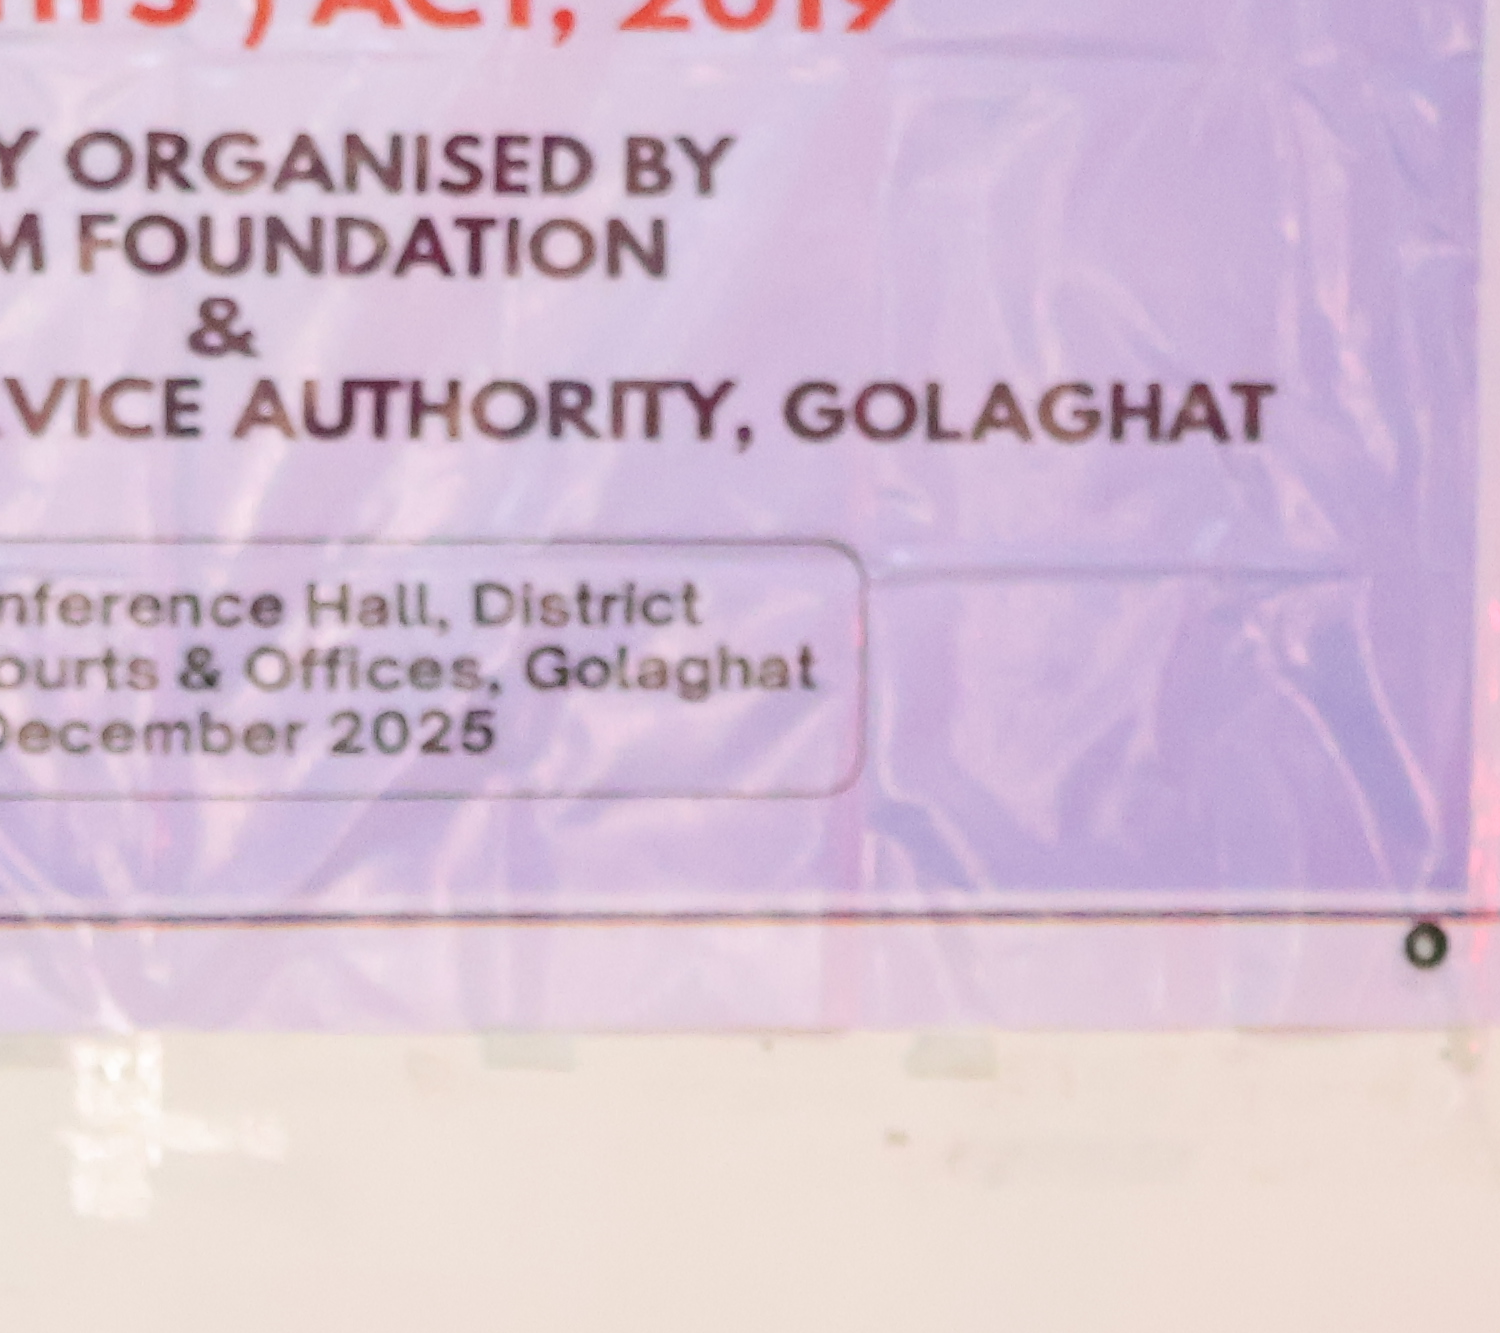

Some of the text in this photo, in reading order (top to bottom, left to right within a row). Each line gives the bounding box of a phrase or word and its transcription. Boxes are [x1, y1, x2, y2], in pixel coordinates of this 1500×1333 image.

[65, 130, 594, 196] ORGANISED
[625, 135, 735, 196] BY
[79, 213, 666, 278] FOUNDATION
[187, 297, 257, 358] &
[234, 378, 753, 451] AUTHORITY,
[783, 380, 1277, 444] GOLAGHAT
[306, 582, 450, 634] Hall,
[473, 582, 703, 629] District
[178, 646, 220, 691] &
[243, 644, 502, 699] Offices,
[524, 644, 817, 702] Golaghat
[330, 709, 496, 755] 2025
